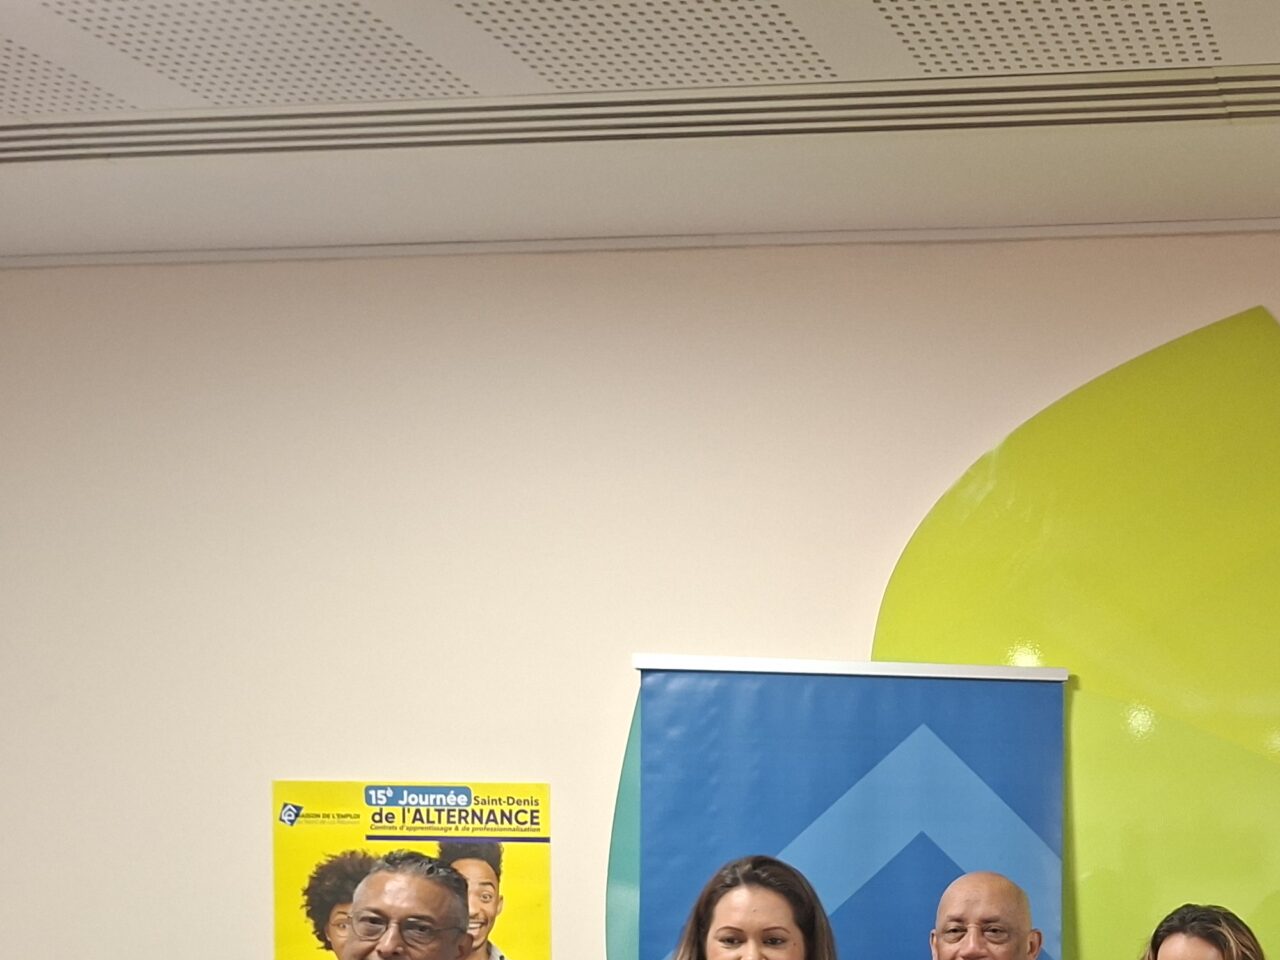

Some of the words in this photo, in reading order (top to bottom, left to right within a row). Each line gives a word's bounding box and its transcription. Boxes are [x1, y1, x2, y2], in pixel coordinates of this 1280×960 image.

[398, 790, 468, 806] Journée
[473, 795, 540, 807] Saint-Denis
[371, 807, 396, 824] de
[402, 807, 540, 826] l'ALTERNANCE
[369, 823, 398, 831] Contrats
